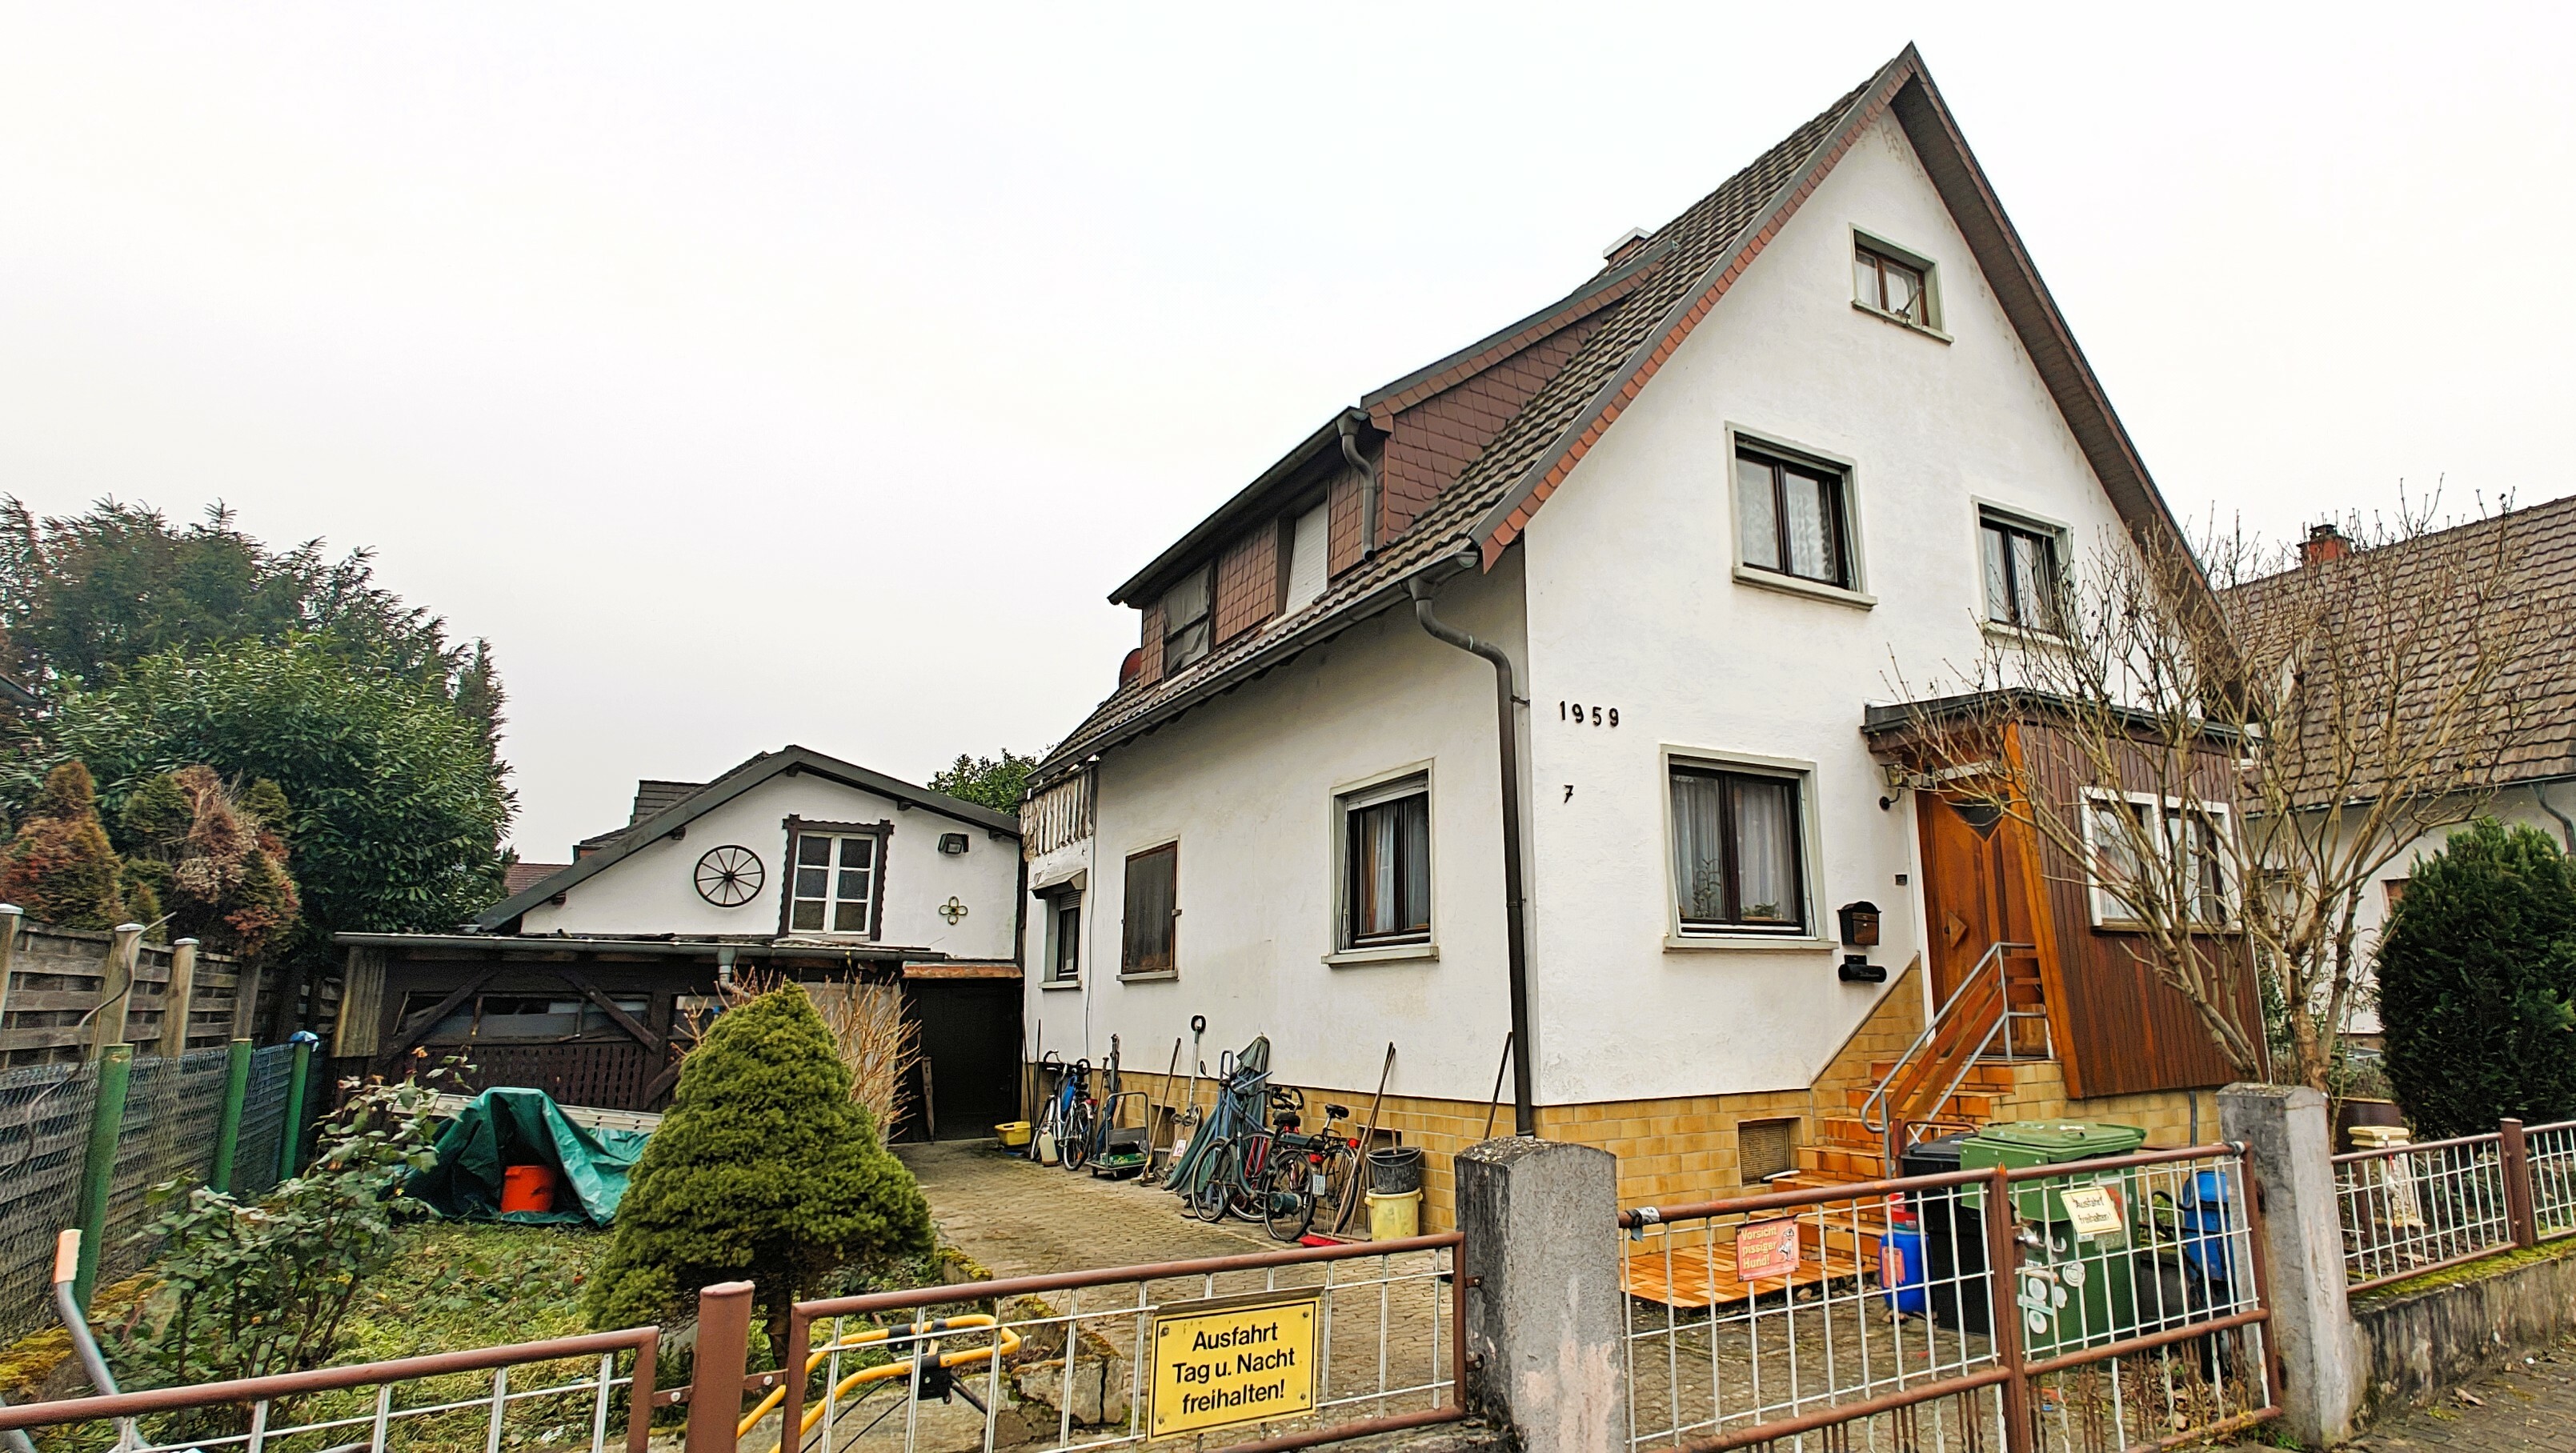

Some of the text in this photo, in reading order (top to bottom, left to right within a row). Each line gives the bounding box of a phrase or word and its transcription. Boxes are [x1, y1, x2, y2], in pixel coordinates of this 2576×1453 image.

[1560, 700, 1620, 727] 1959
[1563, 784, 1575, 804] 7
[1741, 1225, 1777, 1241] Vorsicht
[1742, 1241, 1777, 1257] pissiger
[1742, 1254, 1770, 1270] Hund!
[1192, 1322, 1278, 1352] Ausfahrt
[1172, 1347, 1296, 1384] Tag u. Nacht
[1182, 1379, 1285, 1415] freihalten!
